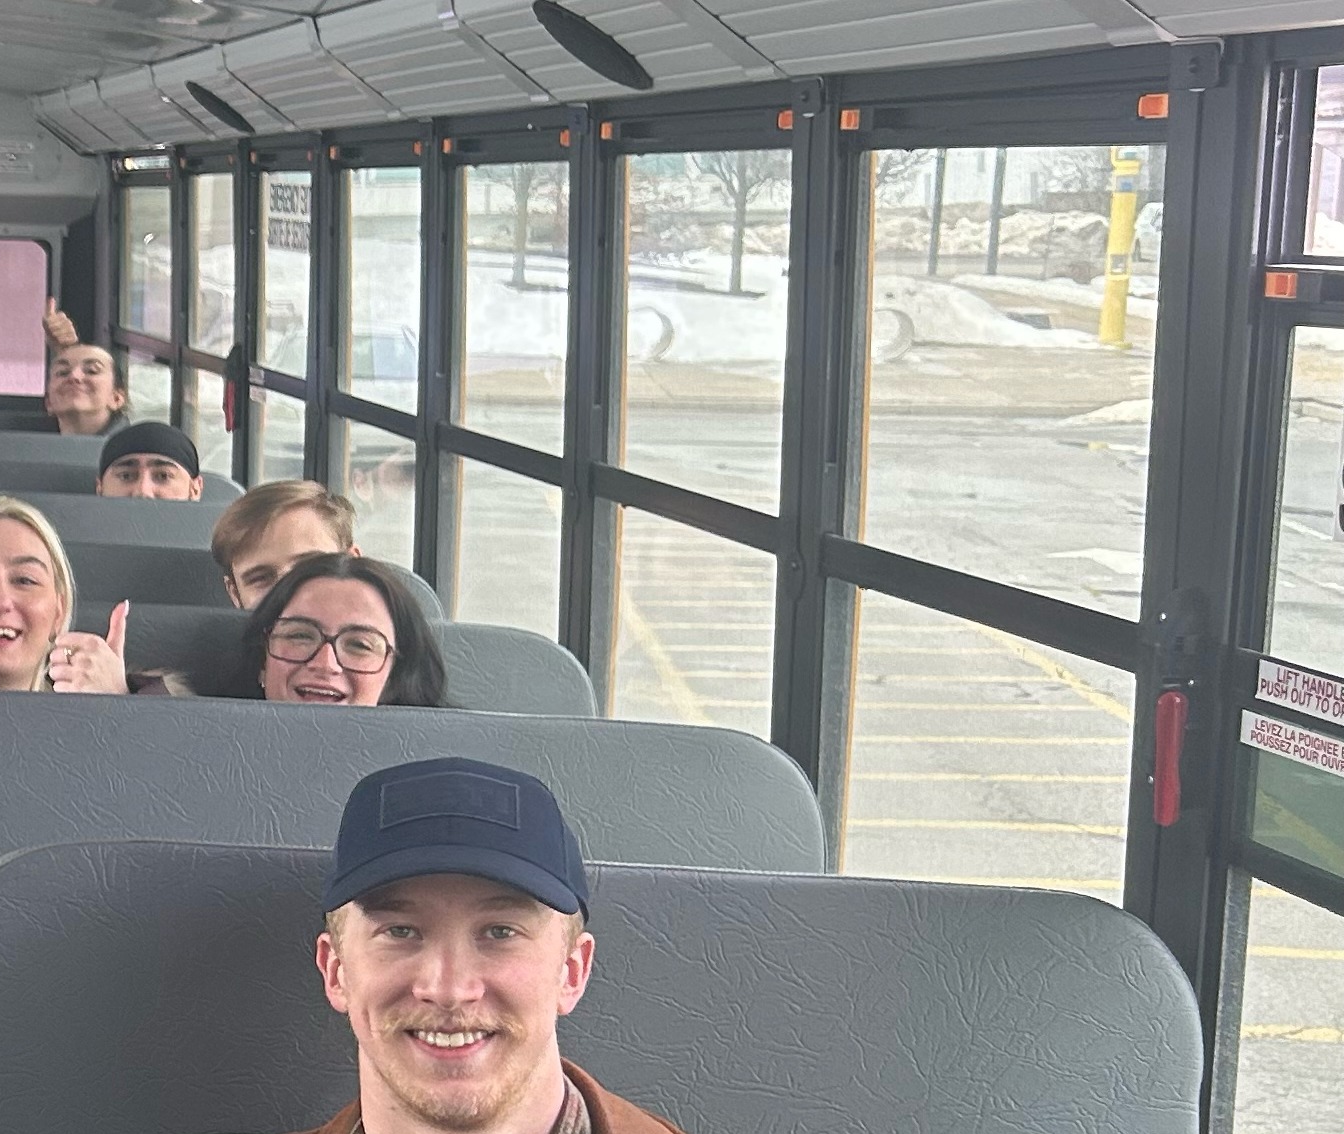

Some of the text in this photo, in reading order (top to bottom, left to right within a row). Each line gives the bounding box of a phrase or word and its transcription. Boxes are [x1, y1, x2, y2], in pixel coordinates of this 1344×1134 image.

[1277, 667, 1300, 687] LIFT
[1260, 678, 1288, 700] PUSH
[1291, 688, 1313, 708] OUT
[1315, 694, 1330, 714] TO
[1250, 730, 1292, 755] POUSSEZ
[1293, 744, 1319, 764] POUR
[1255, 718, 1283, 738] LEVEZ
[1285, 728, 1296, 743] LA
[1298, 732, 1339, 757] POIGNEE
